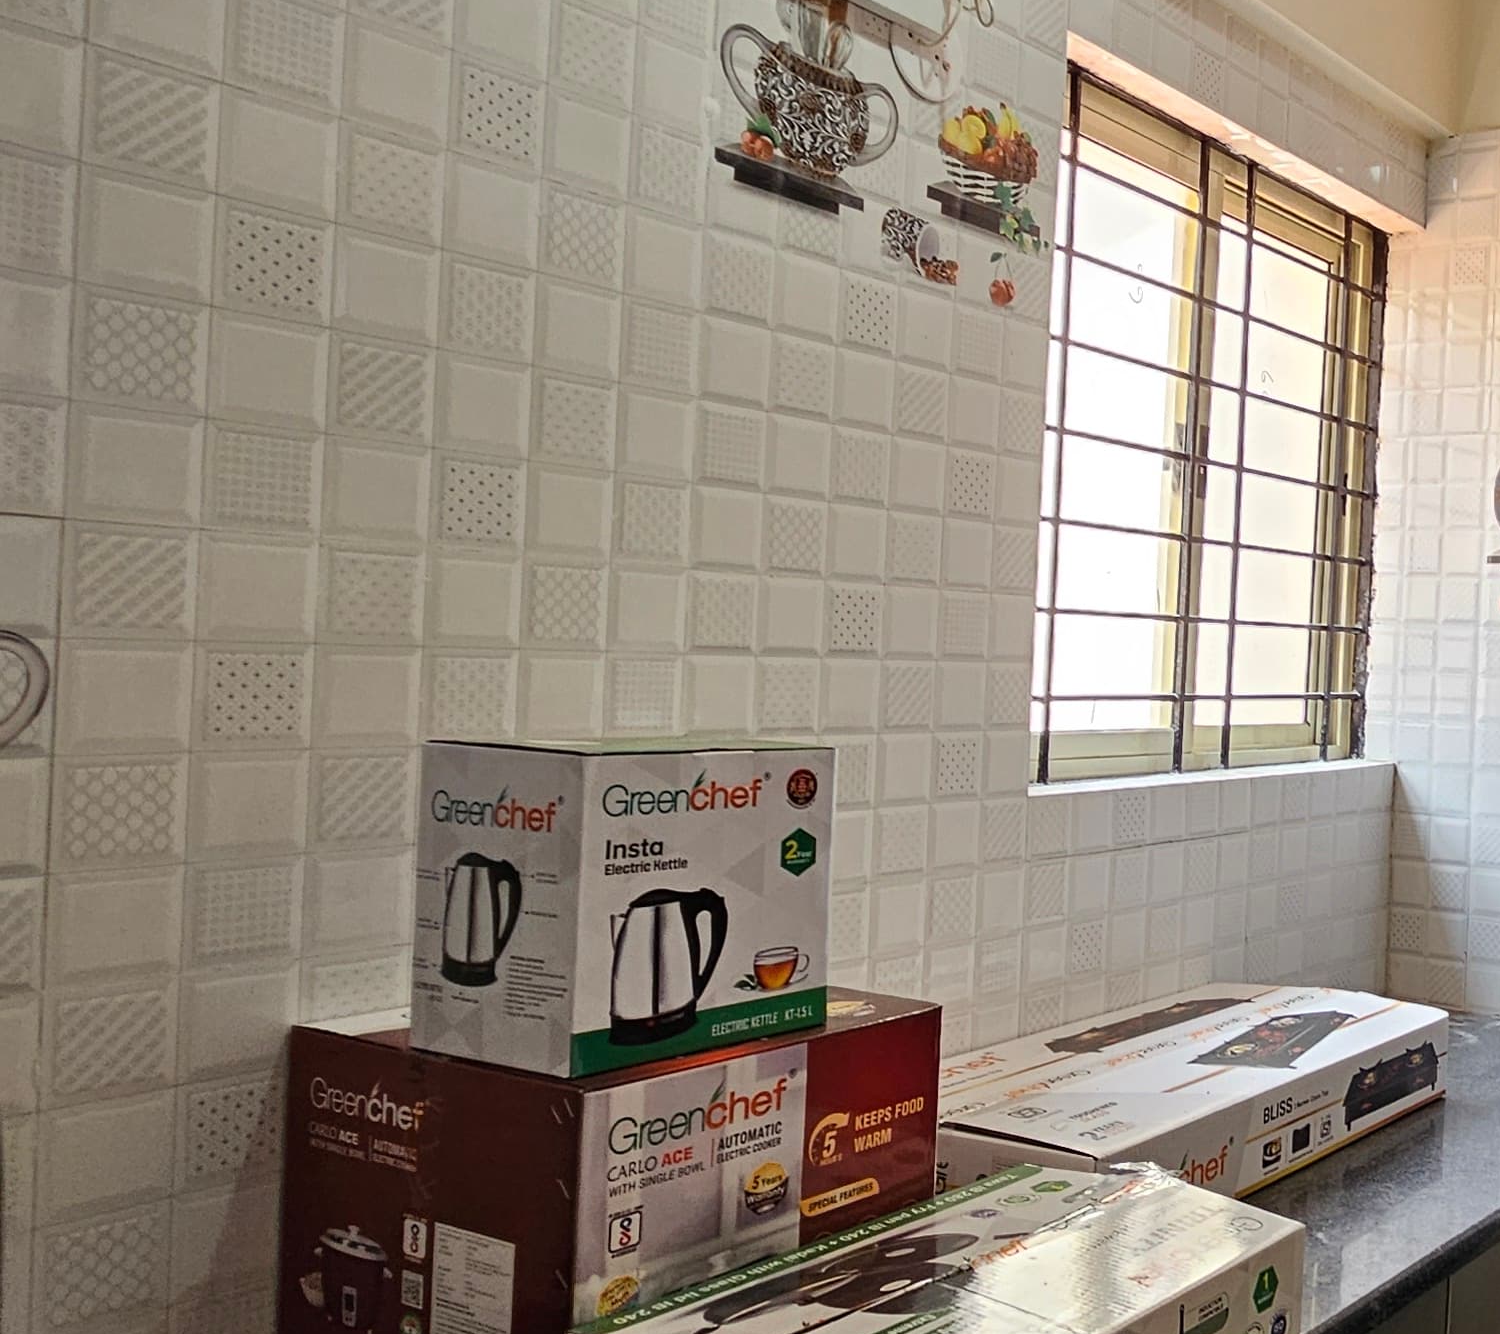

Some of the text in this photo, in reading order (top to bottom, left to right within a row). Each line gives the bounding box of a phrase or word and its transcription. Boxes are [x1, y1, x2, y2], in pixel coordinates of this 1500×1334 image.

[431, 788, 556, 833] Greenchef
[602, 777, 763, 818] Greenchef
[605, 838, 664, 860] Insta
[784, 839, 797, 860] 2
[604, 857, 688, 876] Electric Kettle
[711, 1017, 750, 1037] ELECTRIC
[751, 1011, 779, 1028] KETTLE
[310, 1076, 425, 1133] Greenchef
[608, 1077, 788, 1155] Greenchef
[855, 1106, 893, 1132] KEEPS
[895, 1097, 925, 1118] FOOD
[1263, 1097, 1293, 1124] BLISS
[339, 1129, 359, 1145] ACE
[717, 1121, 783, 1151] AUTOMATIC
[822, 1130, 837, 1158] 5
[854, 1128, 892, 1153] WARM
[716, 1136, 782, 1165] ELECTRIC COOKER
[607, 1146, 694, 1182] CARLO ACE
[608, 1161, 705, 1198] WITH SINGLE BOWL
[751, 1174, 783, 1190] 5 Years
[808, 1182, 874, 1213] SPECIAL FEATURES
[910, 1203, 936, 1217] Fry
[886, 1211, 910, 1225] pan
[747, 1260, 783, 1275] with
[783, 1243, 828, 1267] Kadai
[698, 1273, 748, 1294] Glass
[612, 1308, 651, 1326] 240
